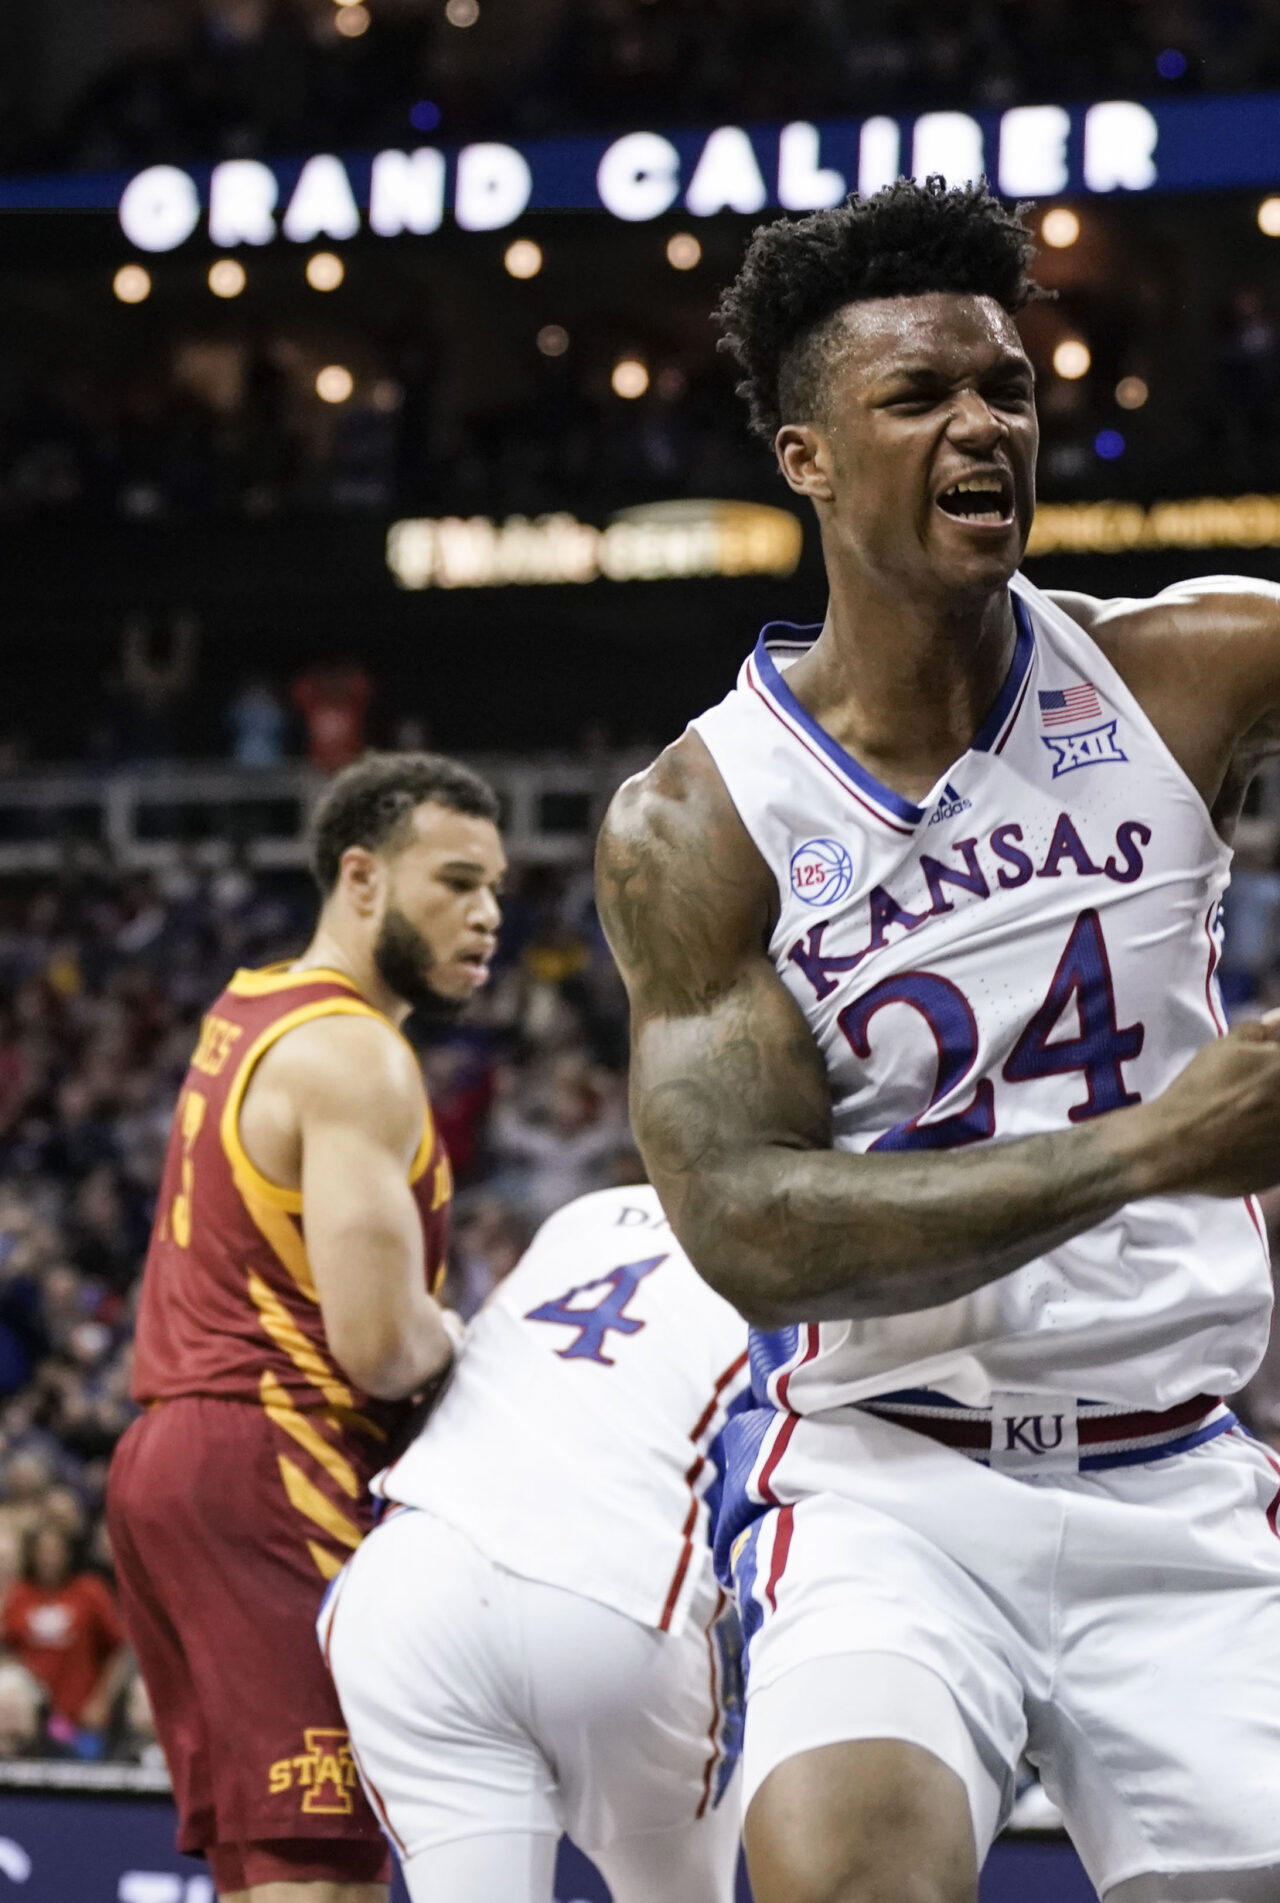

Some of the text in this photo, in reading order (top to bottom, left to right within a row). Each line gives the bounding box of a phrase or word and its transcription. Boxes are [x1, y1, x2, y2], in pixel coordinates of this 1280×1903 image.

[928, 798, 972, 827] didas
[789, 812, 1152, 1001] KANSAS
[795, 862, 826, 888] 125
[837, 907, 1144, 1153] 24
[524, 1252, 671, 1368] 4
[1003, 1414, 1065, 1456] KU
